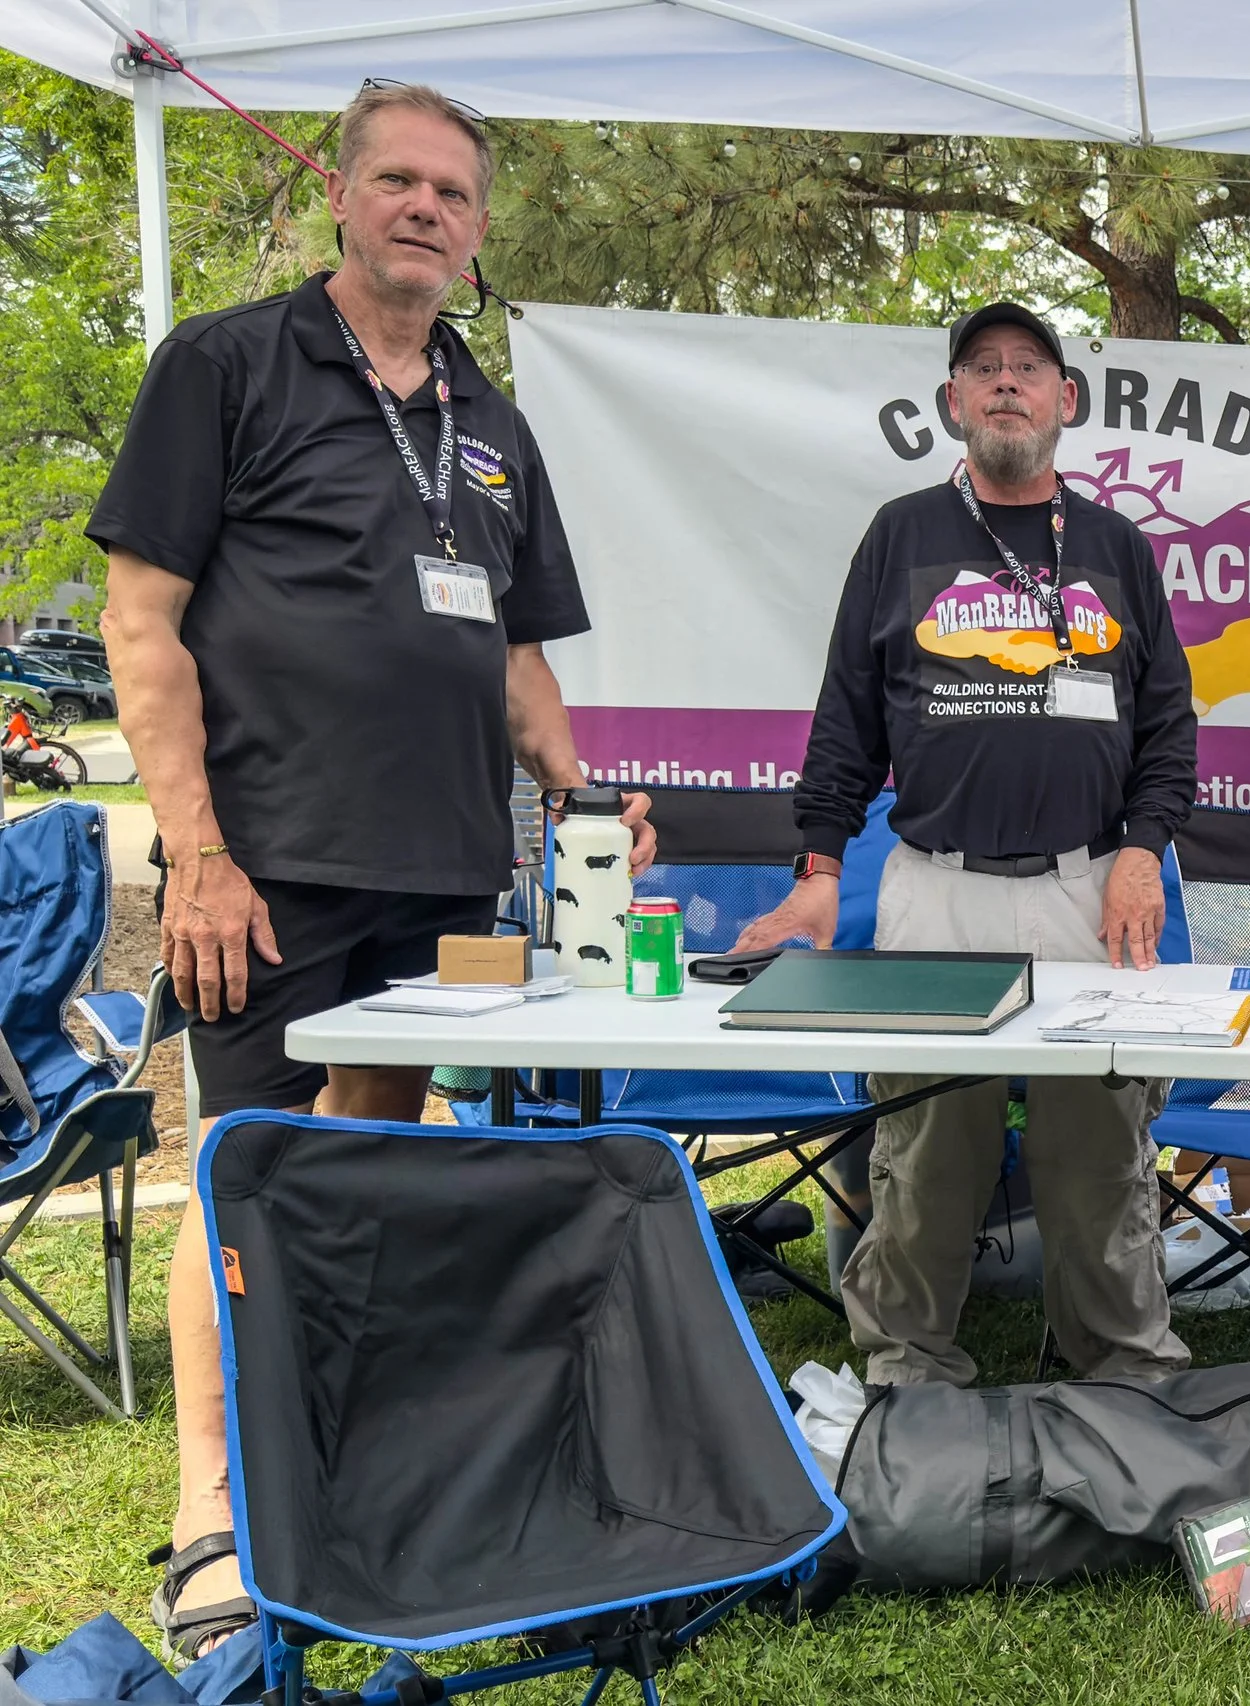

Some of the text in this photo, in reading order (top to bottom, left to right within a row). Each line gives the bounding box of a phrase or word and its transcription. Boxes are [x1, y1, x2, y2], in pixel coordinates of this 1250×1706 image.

[384, 403, 435, 502] ManREACH.org
[435, 411, 455, 501] ManREACH.org
[456, 434, 504, 461] COLORADO
[936, 592, 1107, 650] ManREAC.org
[928, 701, 1026, 716] CONNECTIONS
[1030, 701, 1040, 714] &
[933, 683, 995, 696] BUILDING
